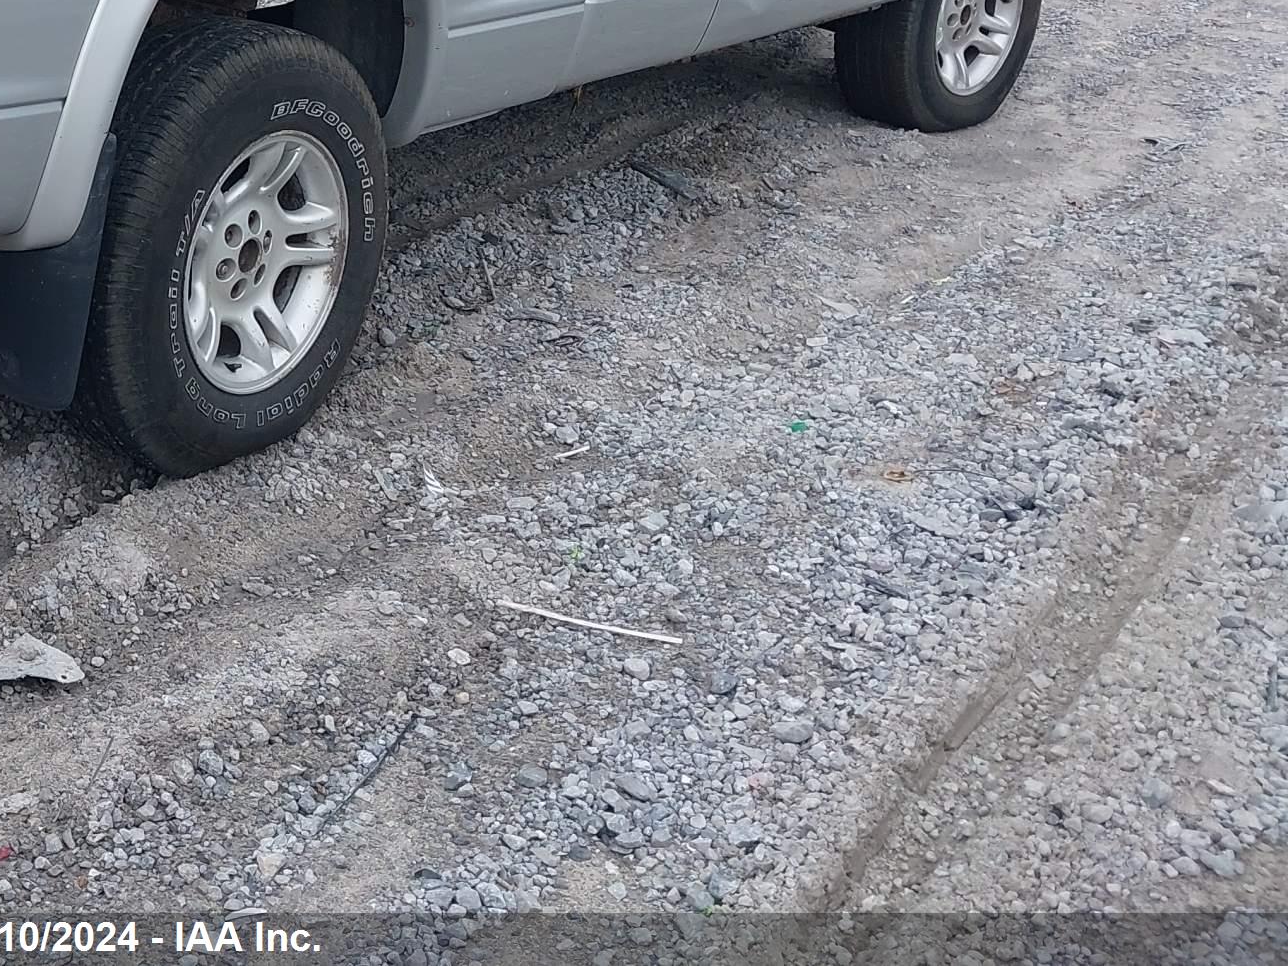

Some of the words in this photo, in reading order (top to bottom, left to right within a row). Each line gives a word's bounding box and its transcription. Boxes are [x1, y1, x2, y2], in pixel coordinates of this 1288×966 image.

[270, 99, 376, 242] BFGoodrich
[175, 189, 206, 257] T/A
[168, 269, 187, 378] Trail
[184, 377, 247, 429] Long
[256, 338, 341, 427] Radial
